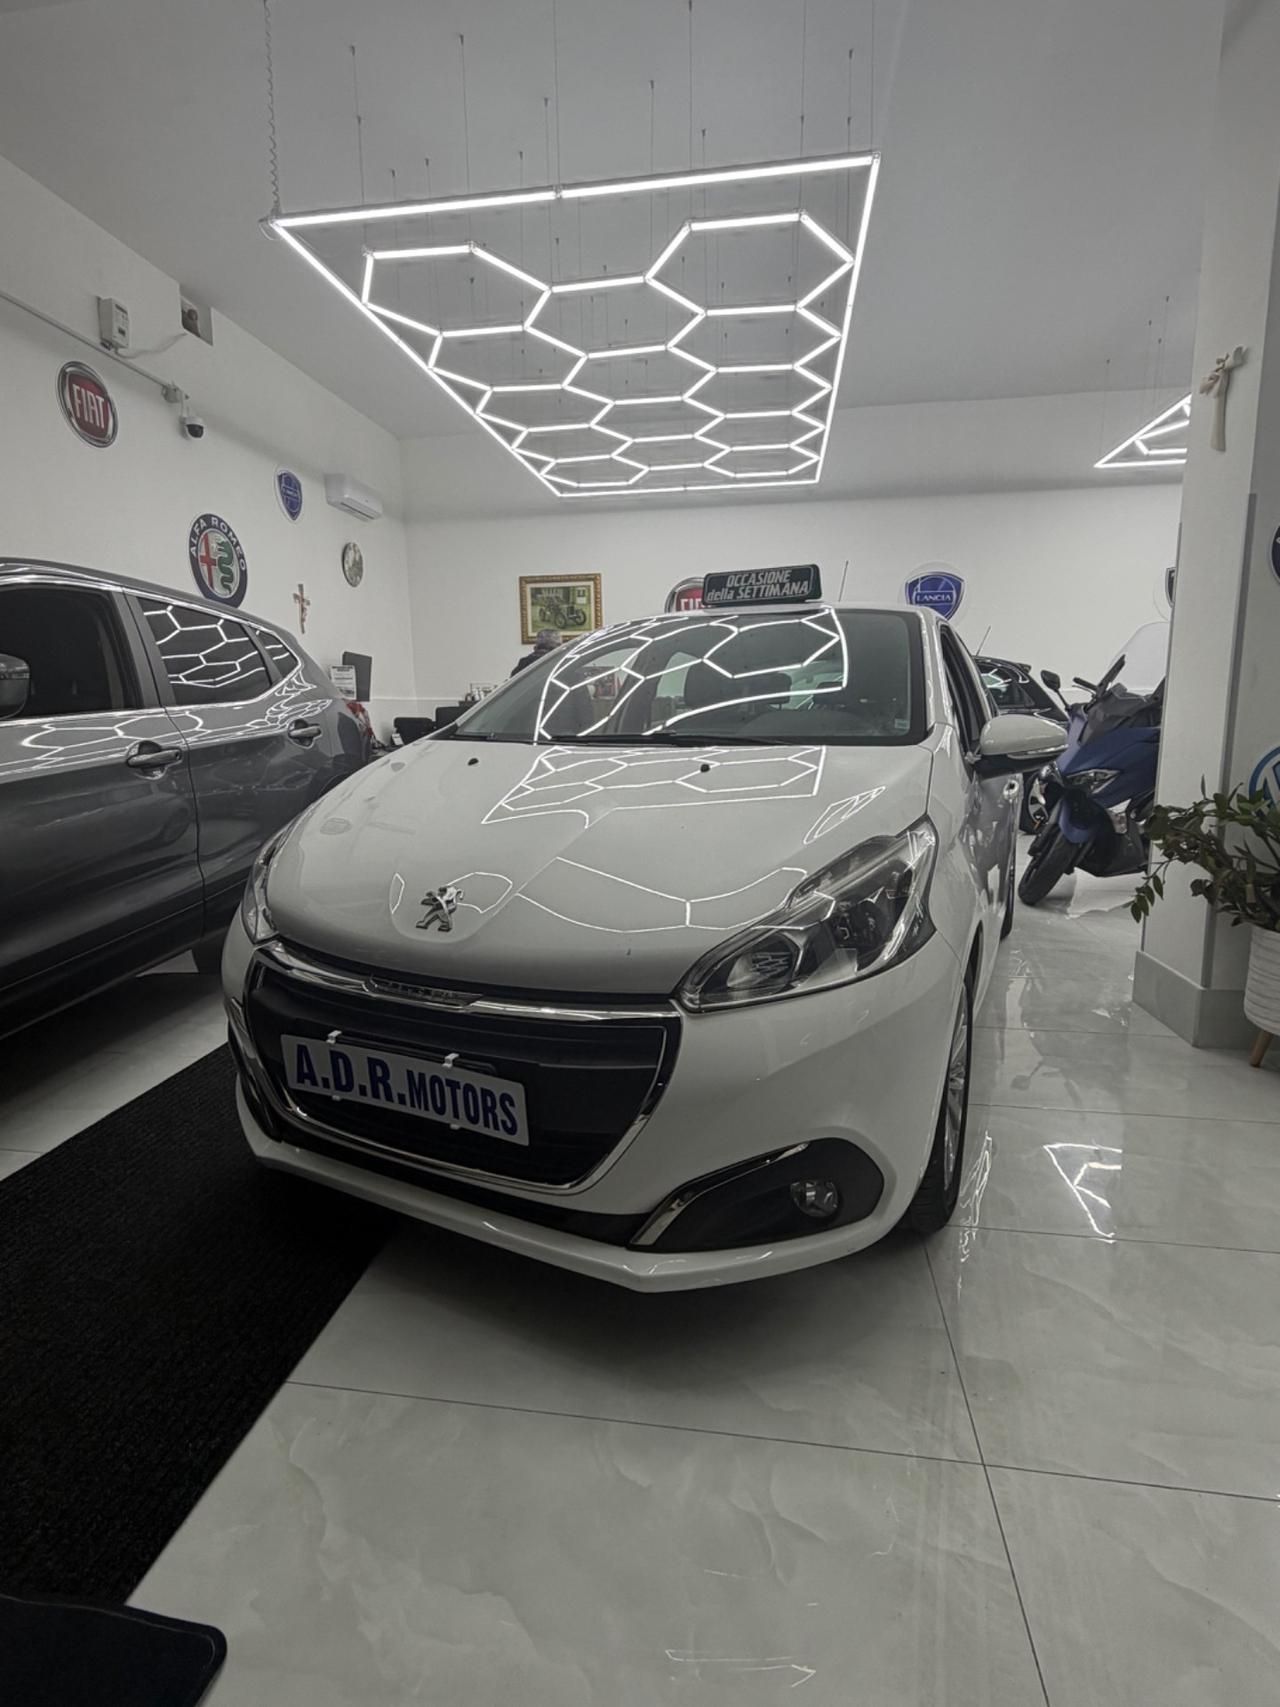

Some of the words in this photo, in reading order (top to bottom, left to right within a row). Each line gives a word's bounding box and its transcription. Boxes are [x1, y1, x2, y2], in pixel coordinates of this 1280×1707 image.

[72, 383, 105, 429] FIAT
[190, 518, 208, 558] ALFA
[211, 516, 246, 571] ROMEO
[726, 569, 793, 588] OCCASIONE
[706, 588, 736, 601] della
[736, 580, 809, 599] SETTIMANA
[916, 594, 951, 602] LANCIA
